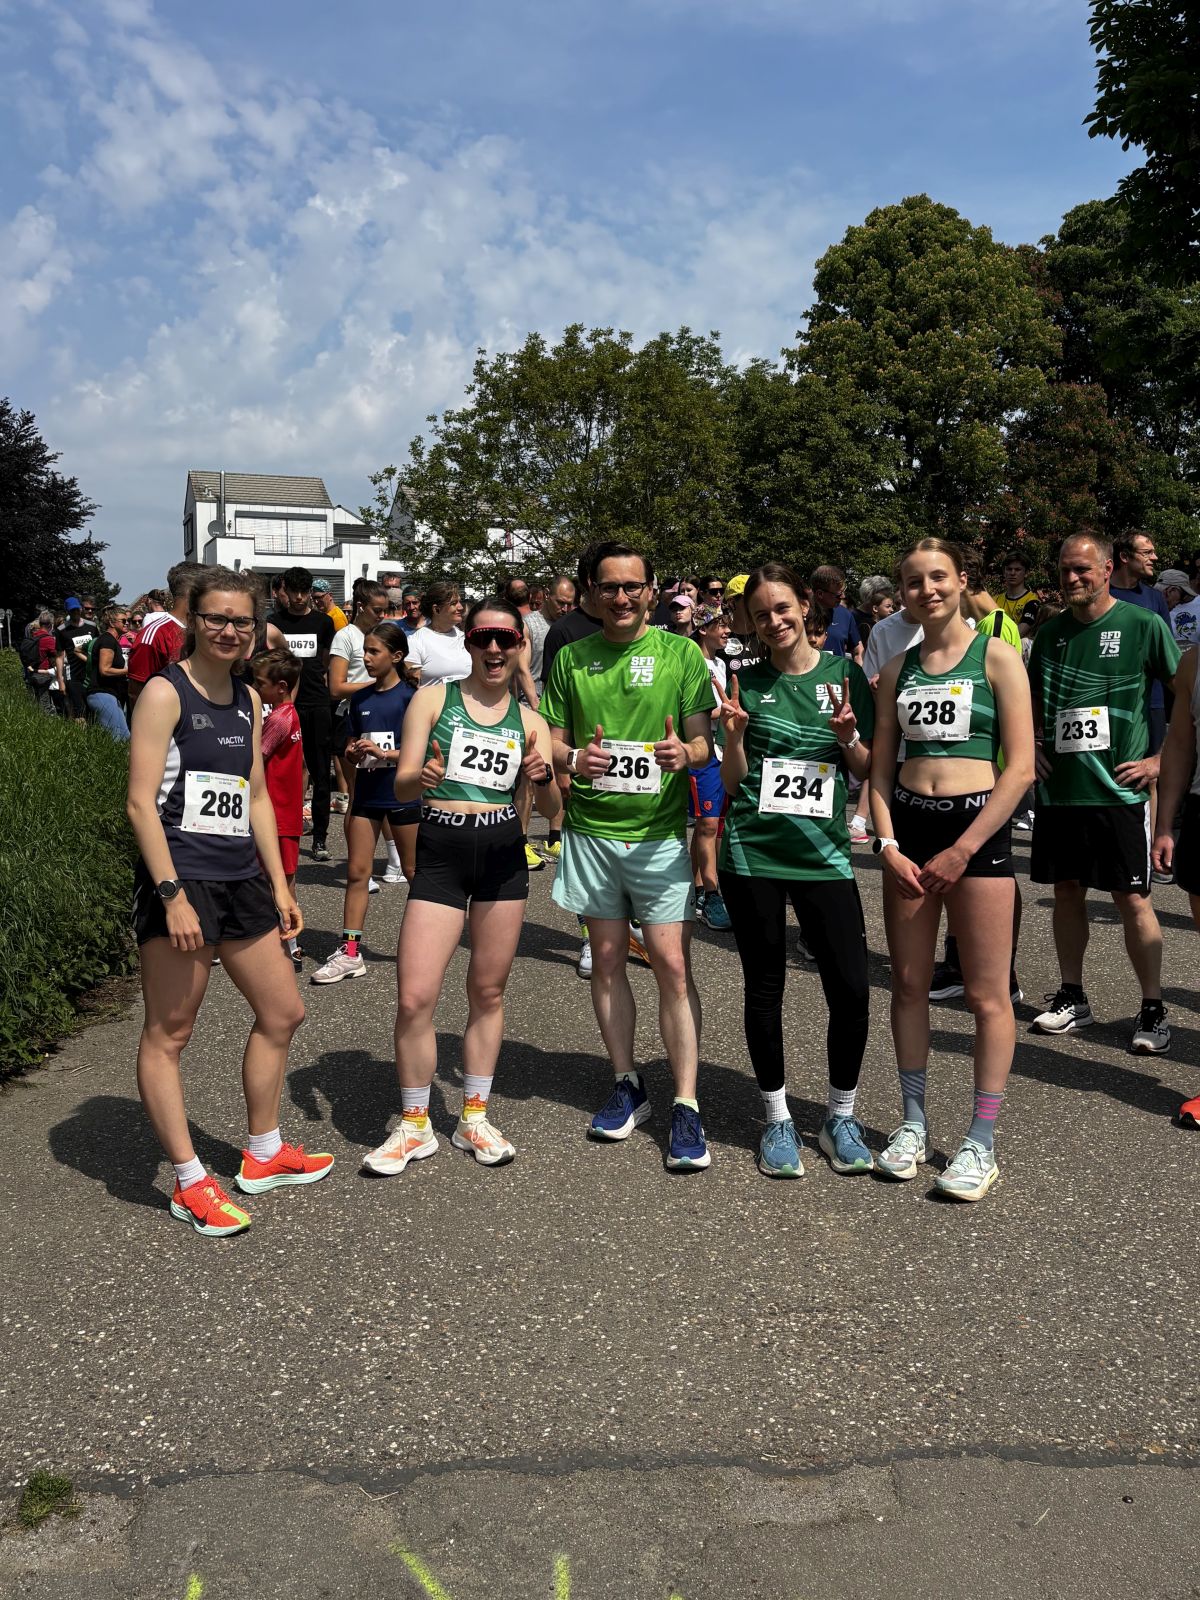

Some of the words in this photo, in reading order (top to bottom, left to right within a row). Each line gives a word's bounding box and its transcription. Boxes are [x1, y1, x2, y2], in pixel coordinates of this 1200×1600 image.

[1100, 630, 1122, 640] SFD
[1099, 641, 1121, 655] 75
[630, 655, 655, 666] SFD
[629, 668, 654, 683] 75
[907, 699, 956, 726] 238
[501, 727, 521, 740] SFD
[1061, 719, 1099, 741] 233
[217, 735, 245, 746] VIACTIV
[460, 745, 510, 776] 235
[603, 754, 650, 780] 236
[773, 774, 823, 802] 234
[199, 789, 243, 820] 288
[909, 796, 954, 811] PRO
[427, 807, 467, 827] PRO
[474, 804, 516, 828] NIKE
